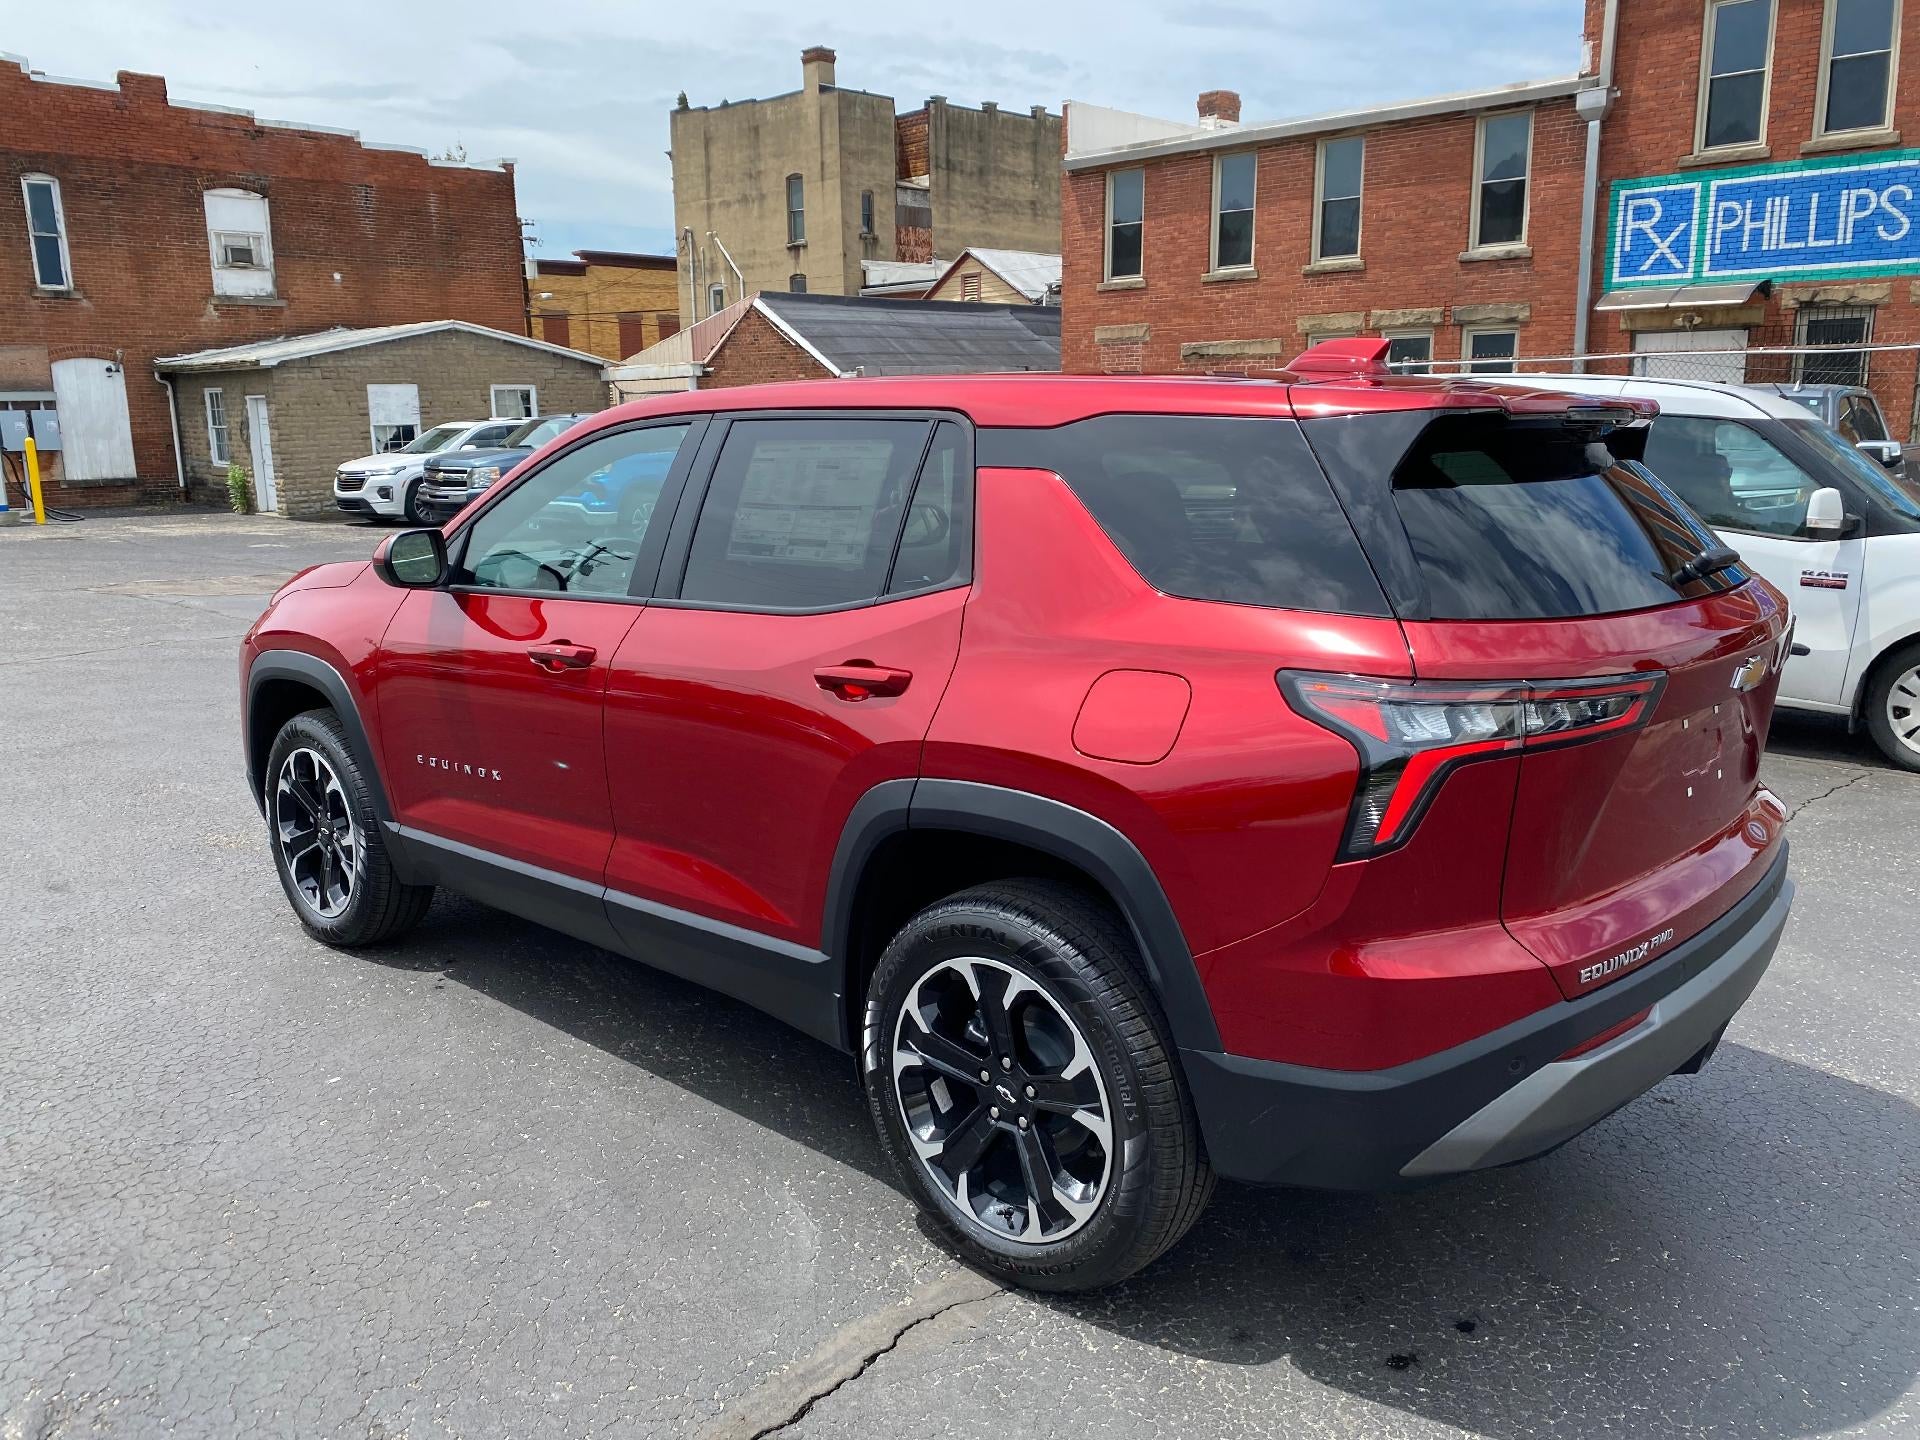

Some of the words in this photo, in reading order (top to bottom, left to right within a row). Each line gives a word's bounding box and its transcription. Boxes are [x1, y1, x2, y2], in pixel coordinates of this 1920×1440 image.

[1714, 184, 1913, 254] PHILLIPS
[416, 754, 502, 780] EQUINOX
[1650, 928, 1674, 949] AWD
[1580, 941, 1650, 983] EQUINOX
